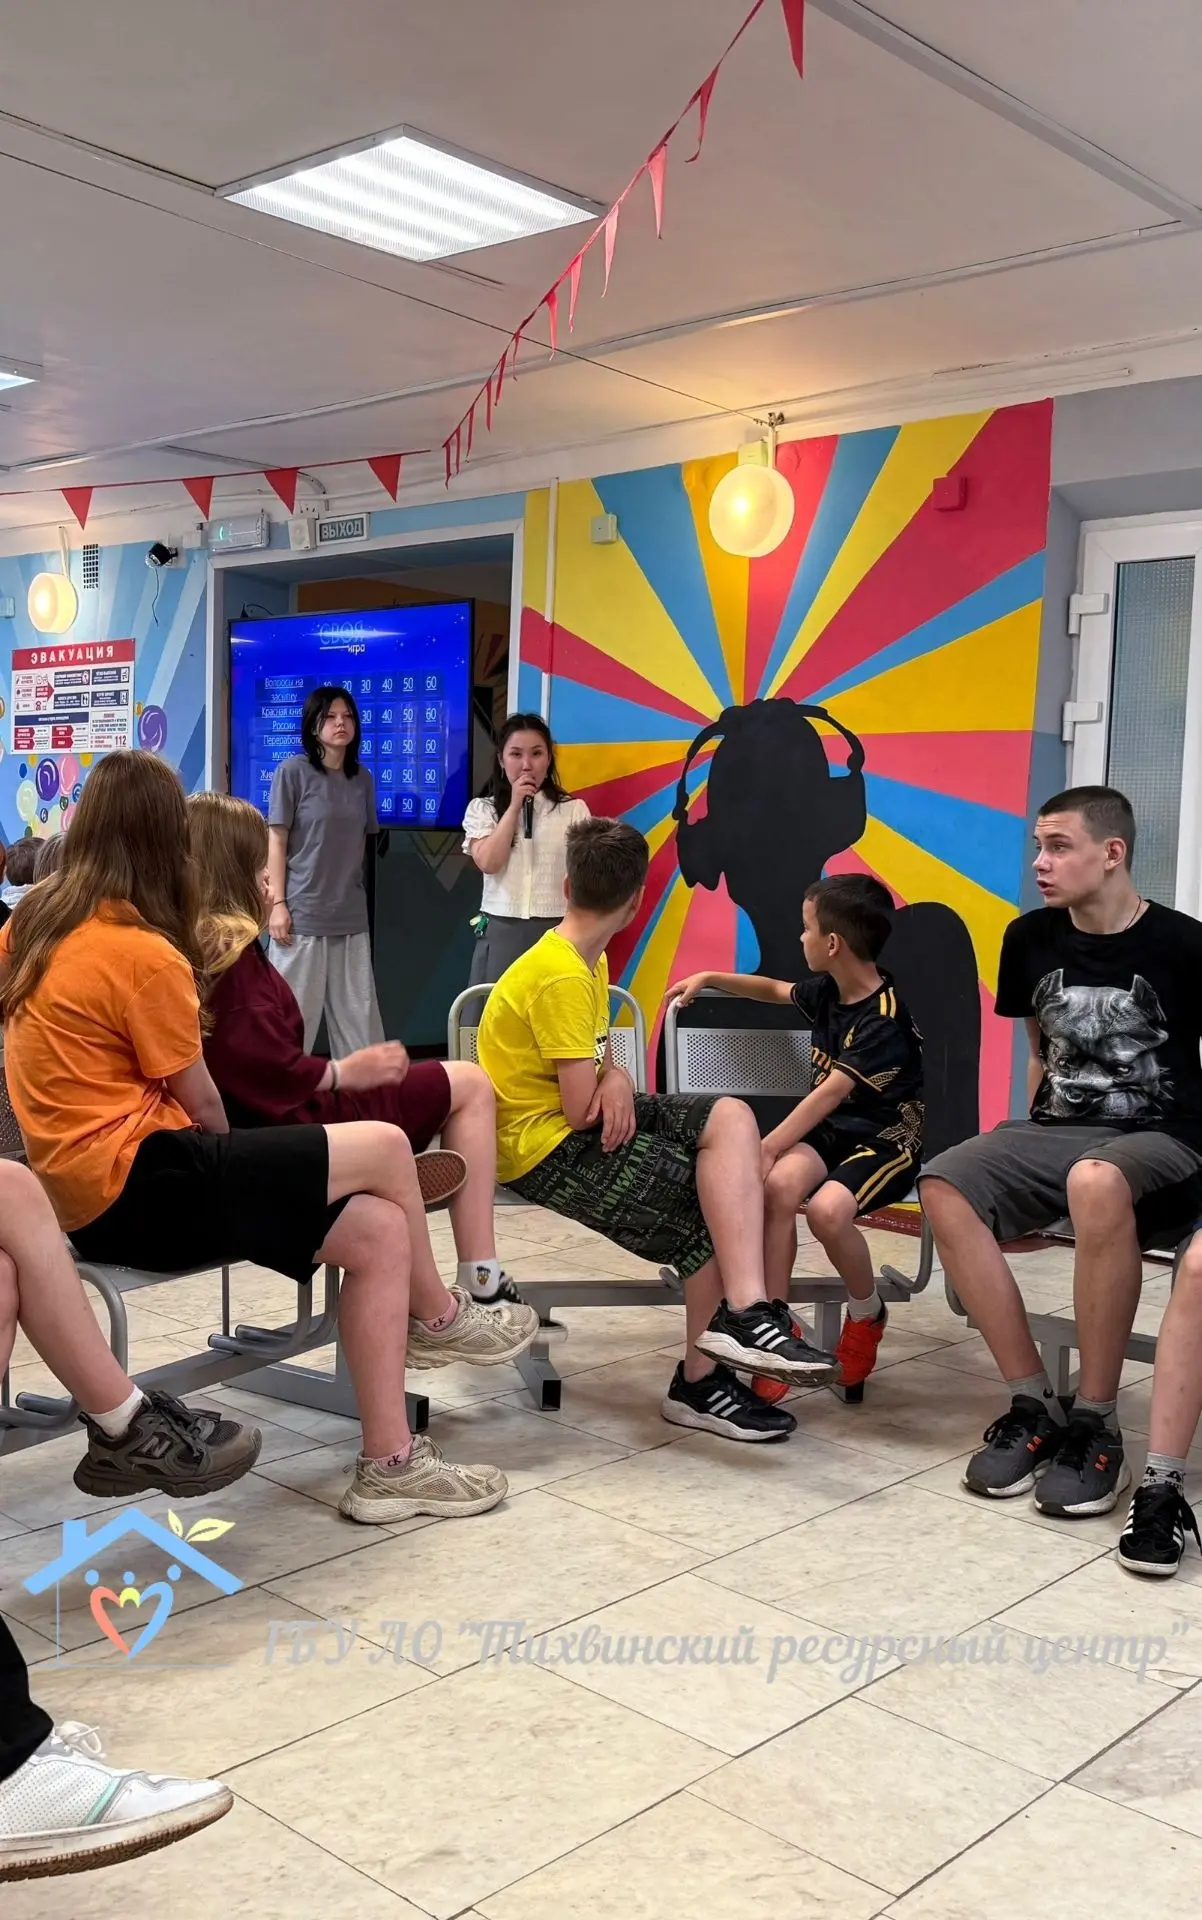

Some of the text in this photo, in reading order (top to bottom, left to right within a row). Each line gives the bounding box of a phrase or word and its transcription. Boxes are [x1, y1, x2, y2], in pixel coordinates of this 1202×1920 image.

[321, 520, 363, 539] ВЫХОД
[320, 620, 364, 645] СВОЯ
[31, 645, 114, 665] ЭВАКУАЦИЯ
[347, 644, 366, 656] игра
[361, 680, 372, 692] 30
[382, 679, 393, 691] 40
[403, 677, 414, 690] 50
[426, 676, 437, 689] 60
[361, 708, 437, 721] 30 40 50 60
[272, 720, 296, 731] России
[115, 735, 127, 746] 112
[361, 739, 437, 752] 30 40 50 60
[382, 769, 437, 781] 40 50 60
[382, 798, 436, 811] 40 50 60
